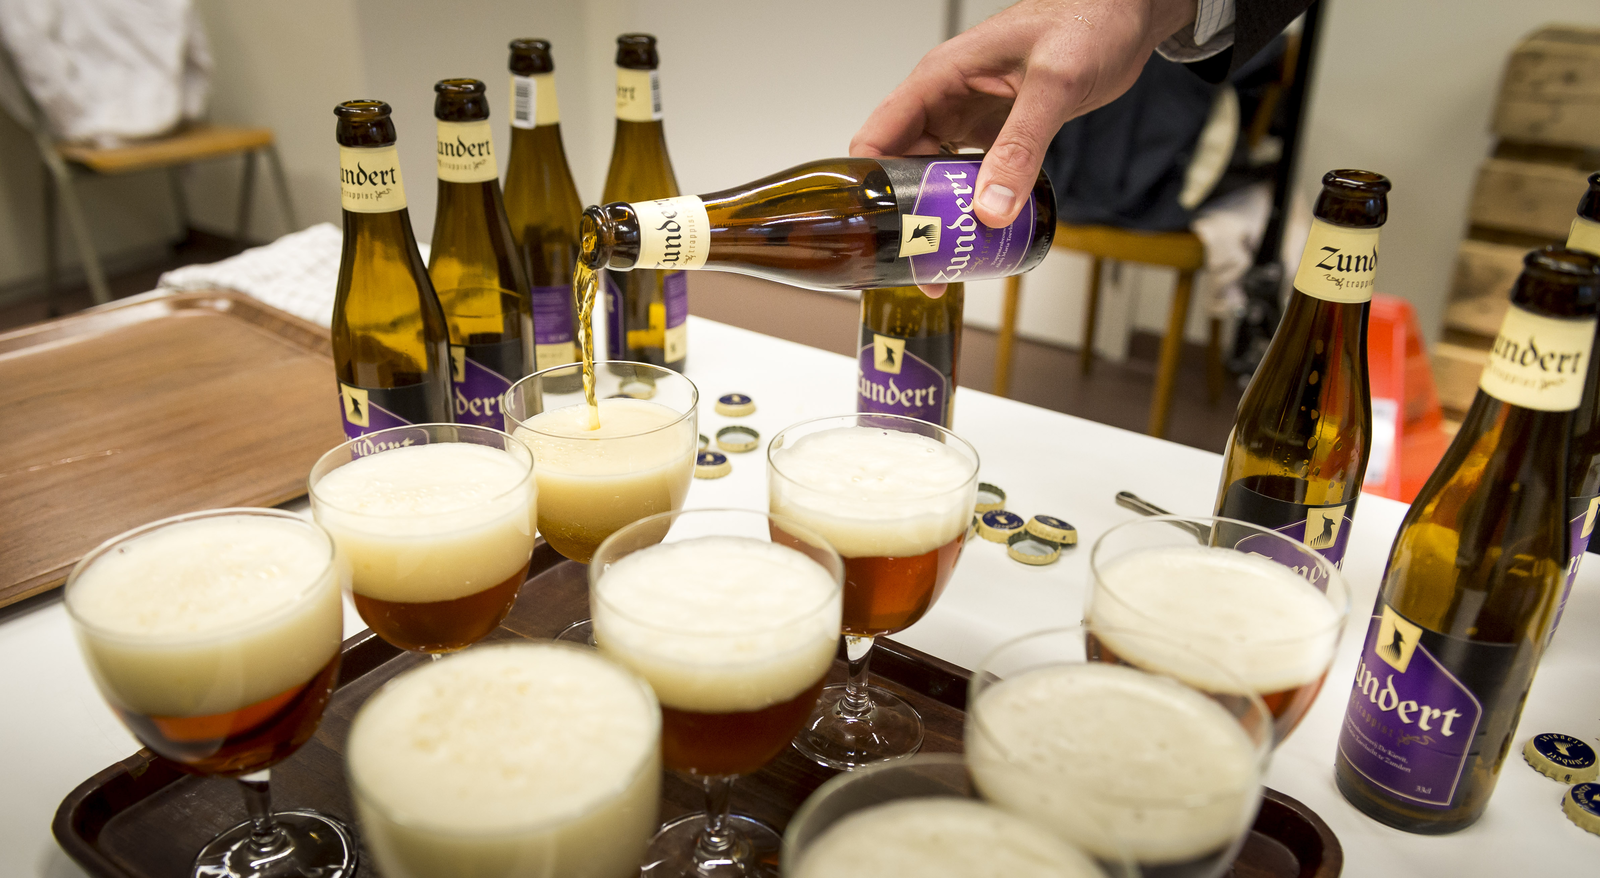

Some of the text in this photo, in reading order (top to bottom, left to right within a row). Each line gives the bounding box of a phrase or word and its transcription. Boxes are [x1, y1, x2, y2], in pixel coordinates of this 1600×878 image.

[438, 135, 490, 157] undert
[340, 161, 396, 186] undert
[686, 215, 697, 254] trappist
[931, 170, 978, 283] Zundert
[981, 226, 994, 255] trapp
[1315, 244, 1378, 273] Zund
[1346, 278, 1374, 289] trappi
[1493, 335, 1581, 373] undert
[456, 386, 516, 416] dert
[859, 371, 937, 407] undert
[1356, 656, 1463, 737] undert
